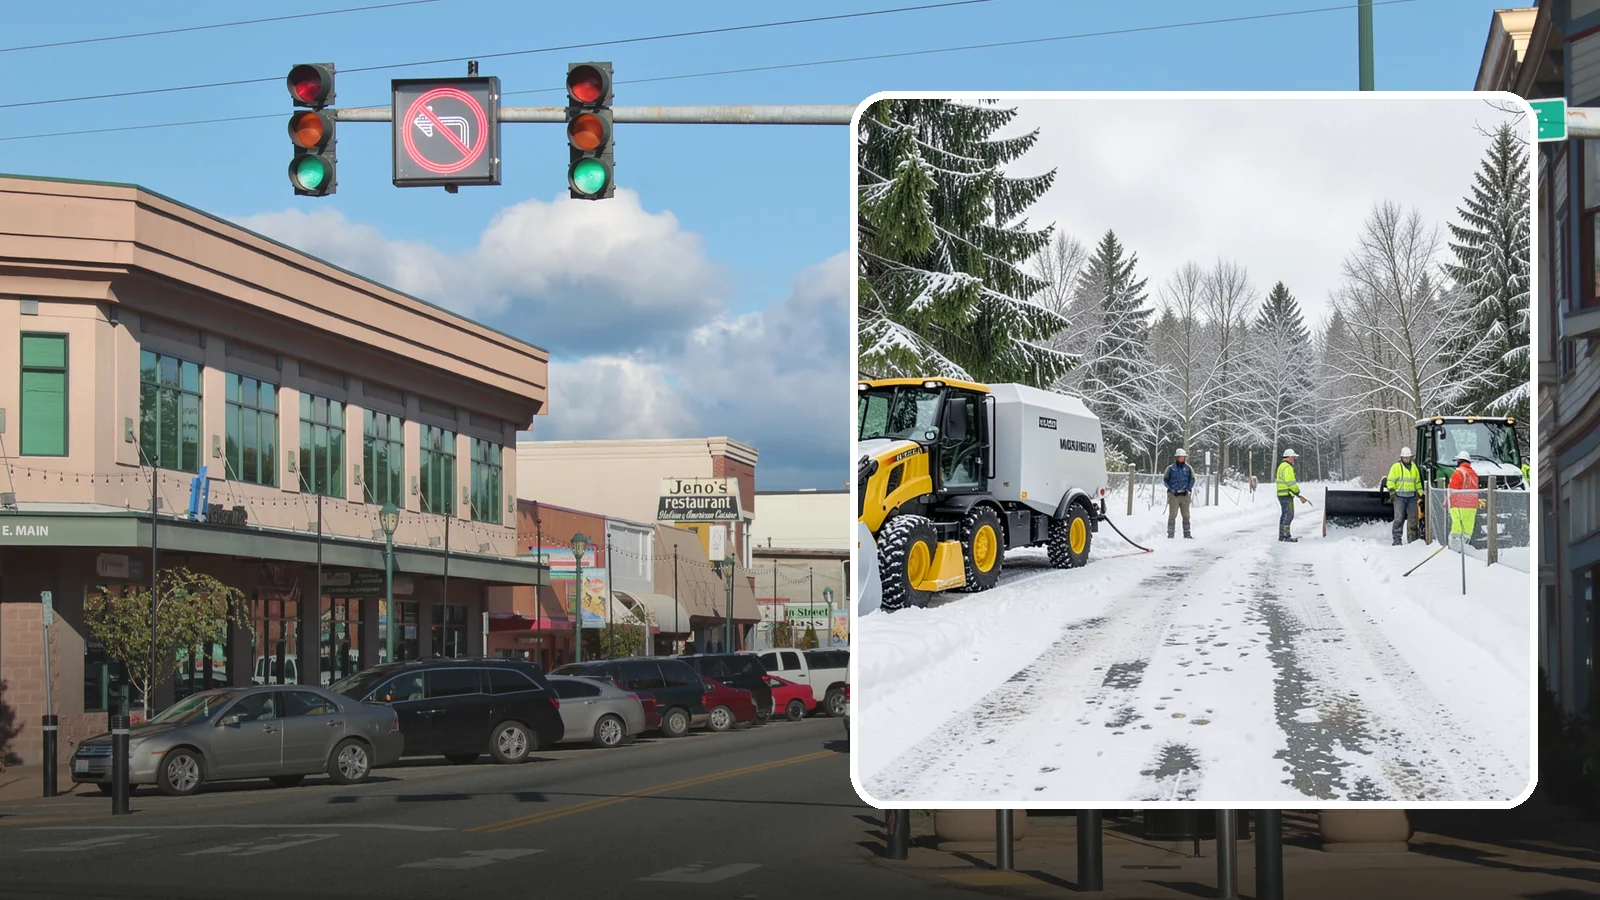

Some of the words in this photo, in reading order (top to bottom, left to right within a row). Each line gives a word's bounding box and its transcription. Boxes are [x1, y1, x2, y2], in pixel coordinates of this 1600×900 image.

[669, 480, 727, 494] Jeno's
[665, 496, 731, 509] restaurant
[658, 510, 682, 520] Italian
[686, 509, 715, 520] American
[714, 509, 737, 519] Cuisine
[2, 525, 13, 536] E.
[15, 525, 48, 536] MAIN
[797, 608, 828, 617] Street
